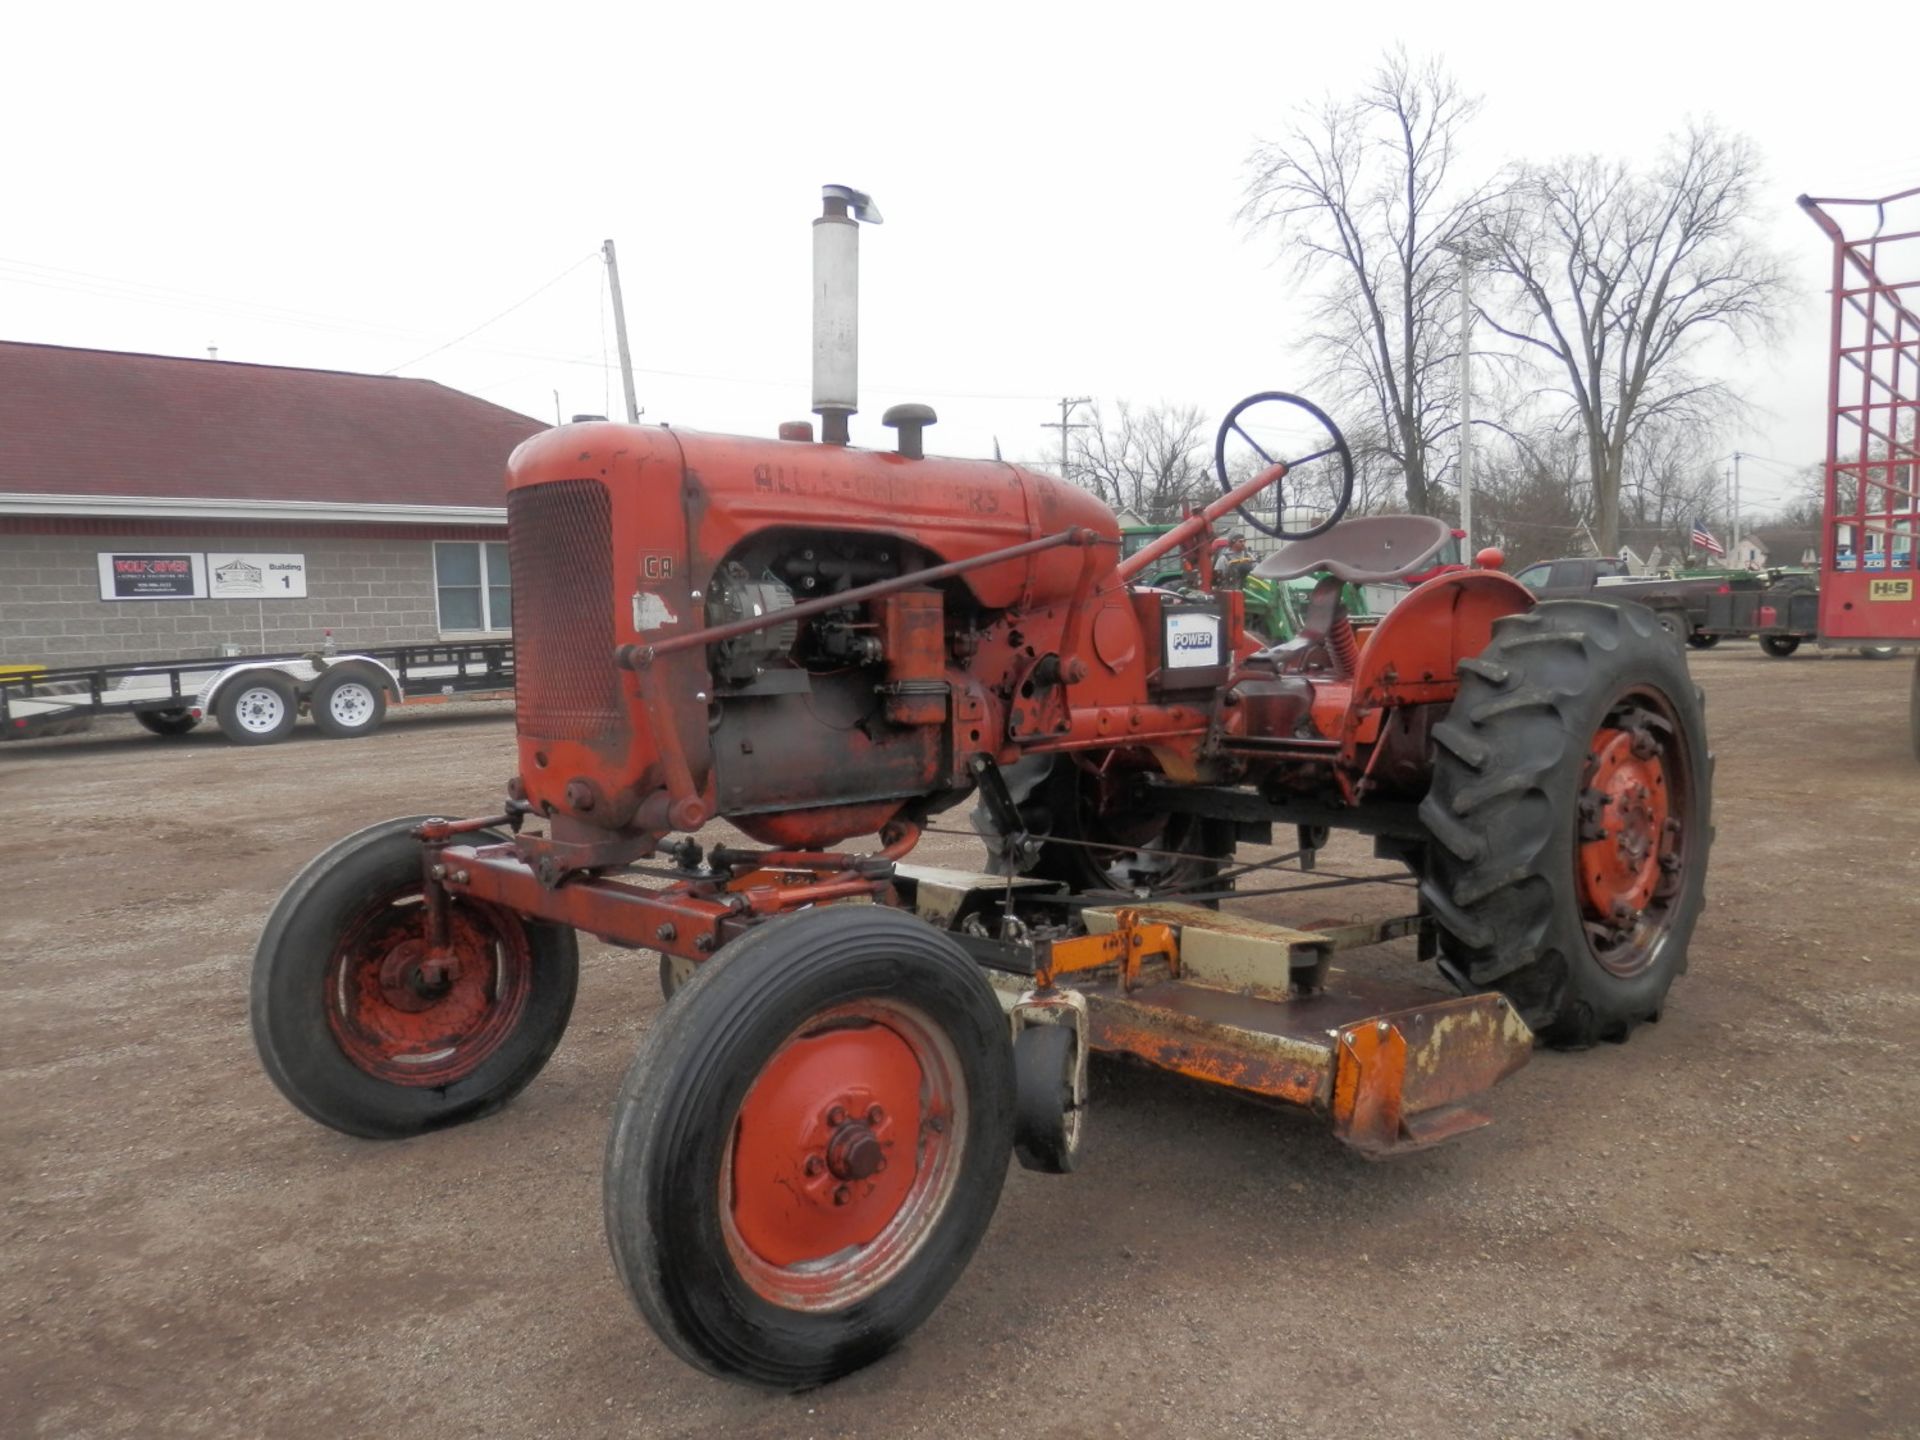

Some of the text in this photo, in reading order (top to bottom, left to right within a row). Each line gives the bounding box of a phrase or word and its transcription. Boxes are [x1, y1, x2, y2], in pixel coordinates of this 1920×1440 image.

[644, 556, 673, 578] CA
[281, 575, 290, 589] 1
[1874, 582, 1909, 594] H&S
[1173, 631, 1213, 650] POWER
